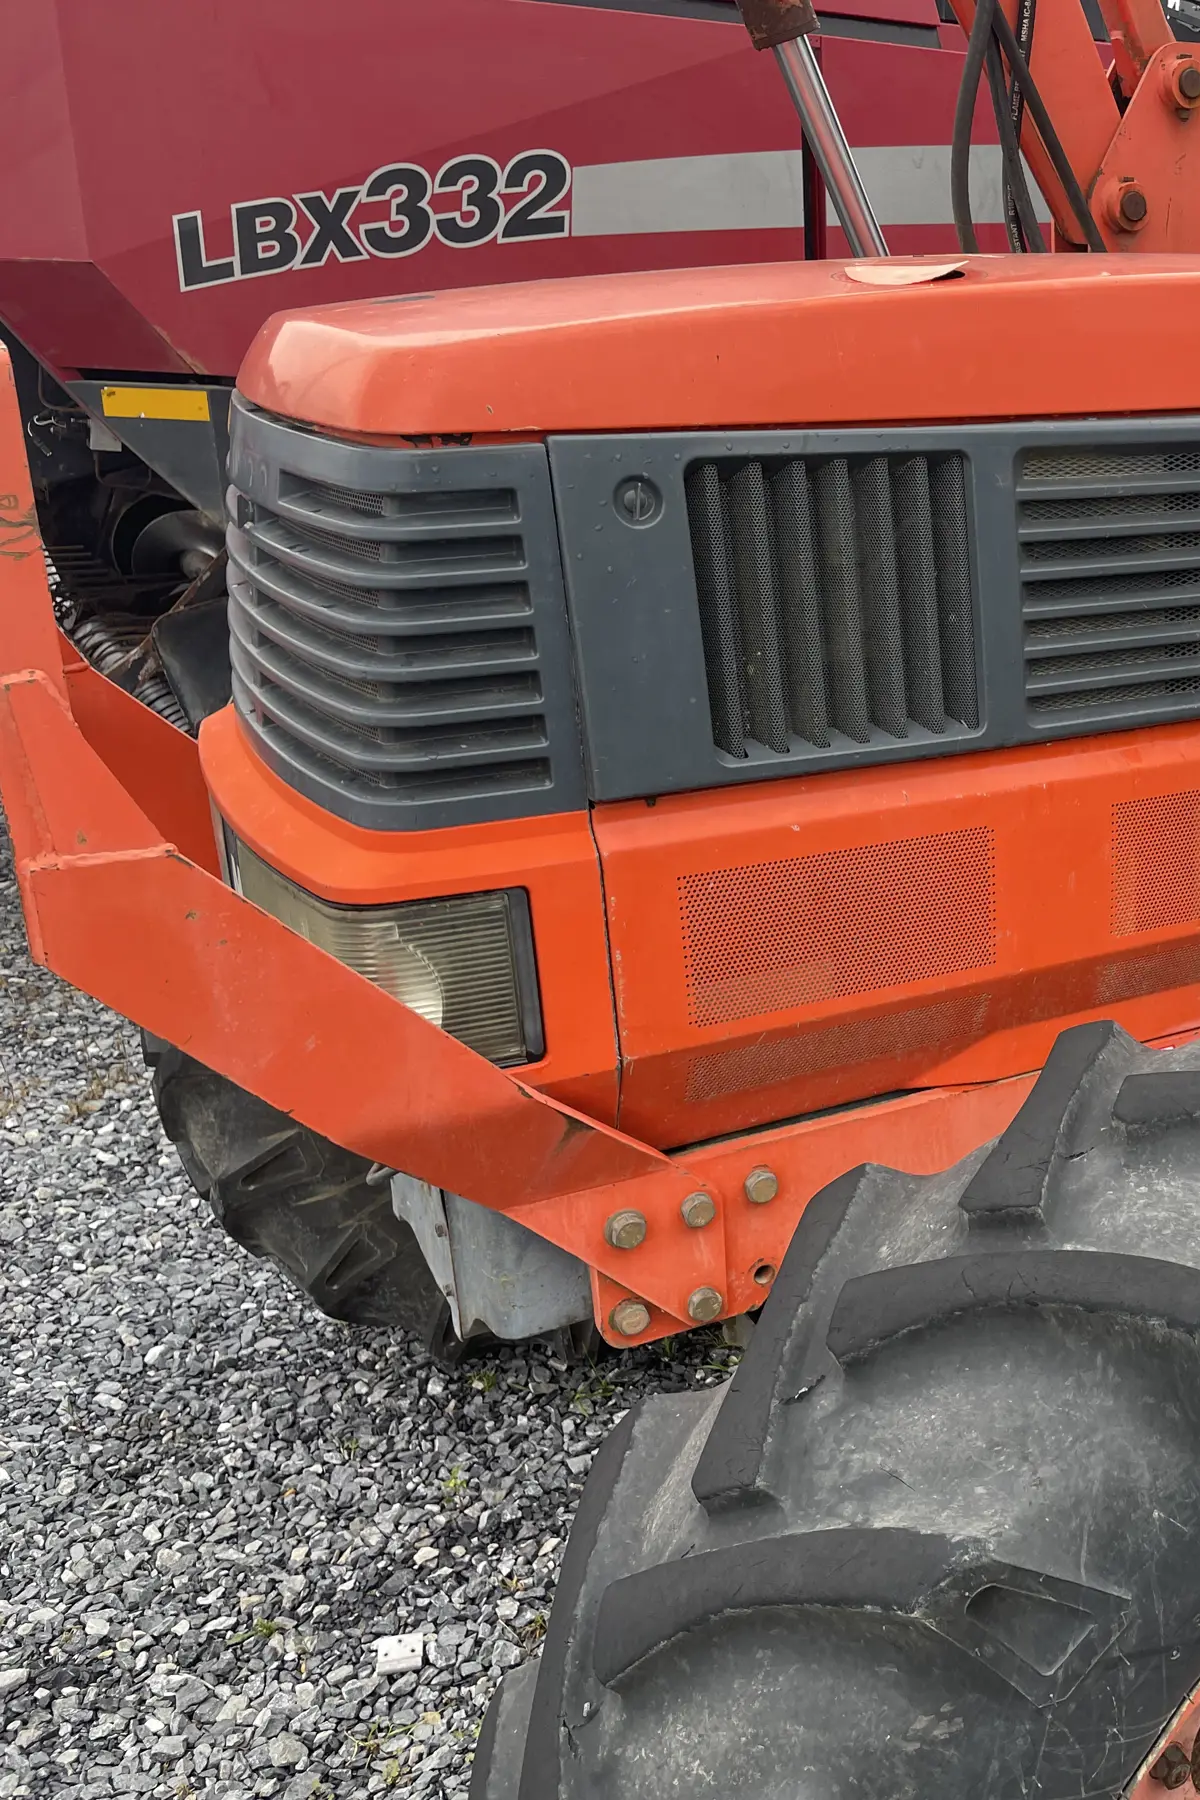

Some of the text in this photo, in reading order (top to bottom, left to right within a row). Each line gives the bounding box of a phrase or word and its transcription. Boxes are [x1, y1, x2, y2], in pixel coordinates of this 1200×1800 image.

[1023, 0, 1032, 17] IC-8
[1020, 18, 1029, 42] MSHA
[172, 148, 573, 292] LBX332
